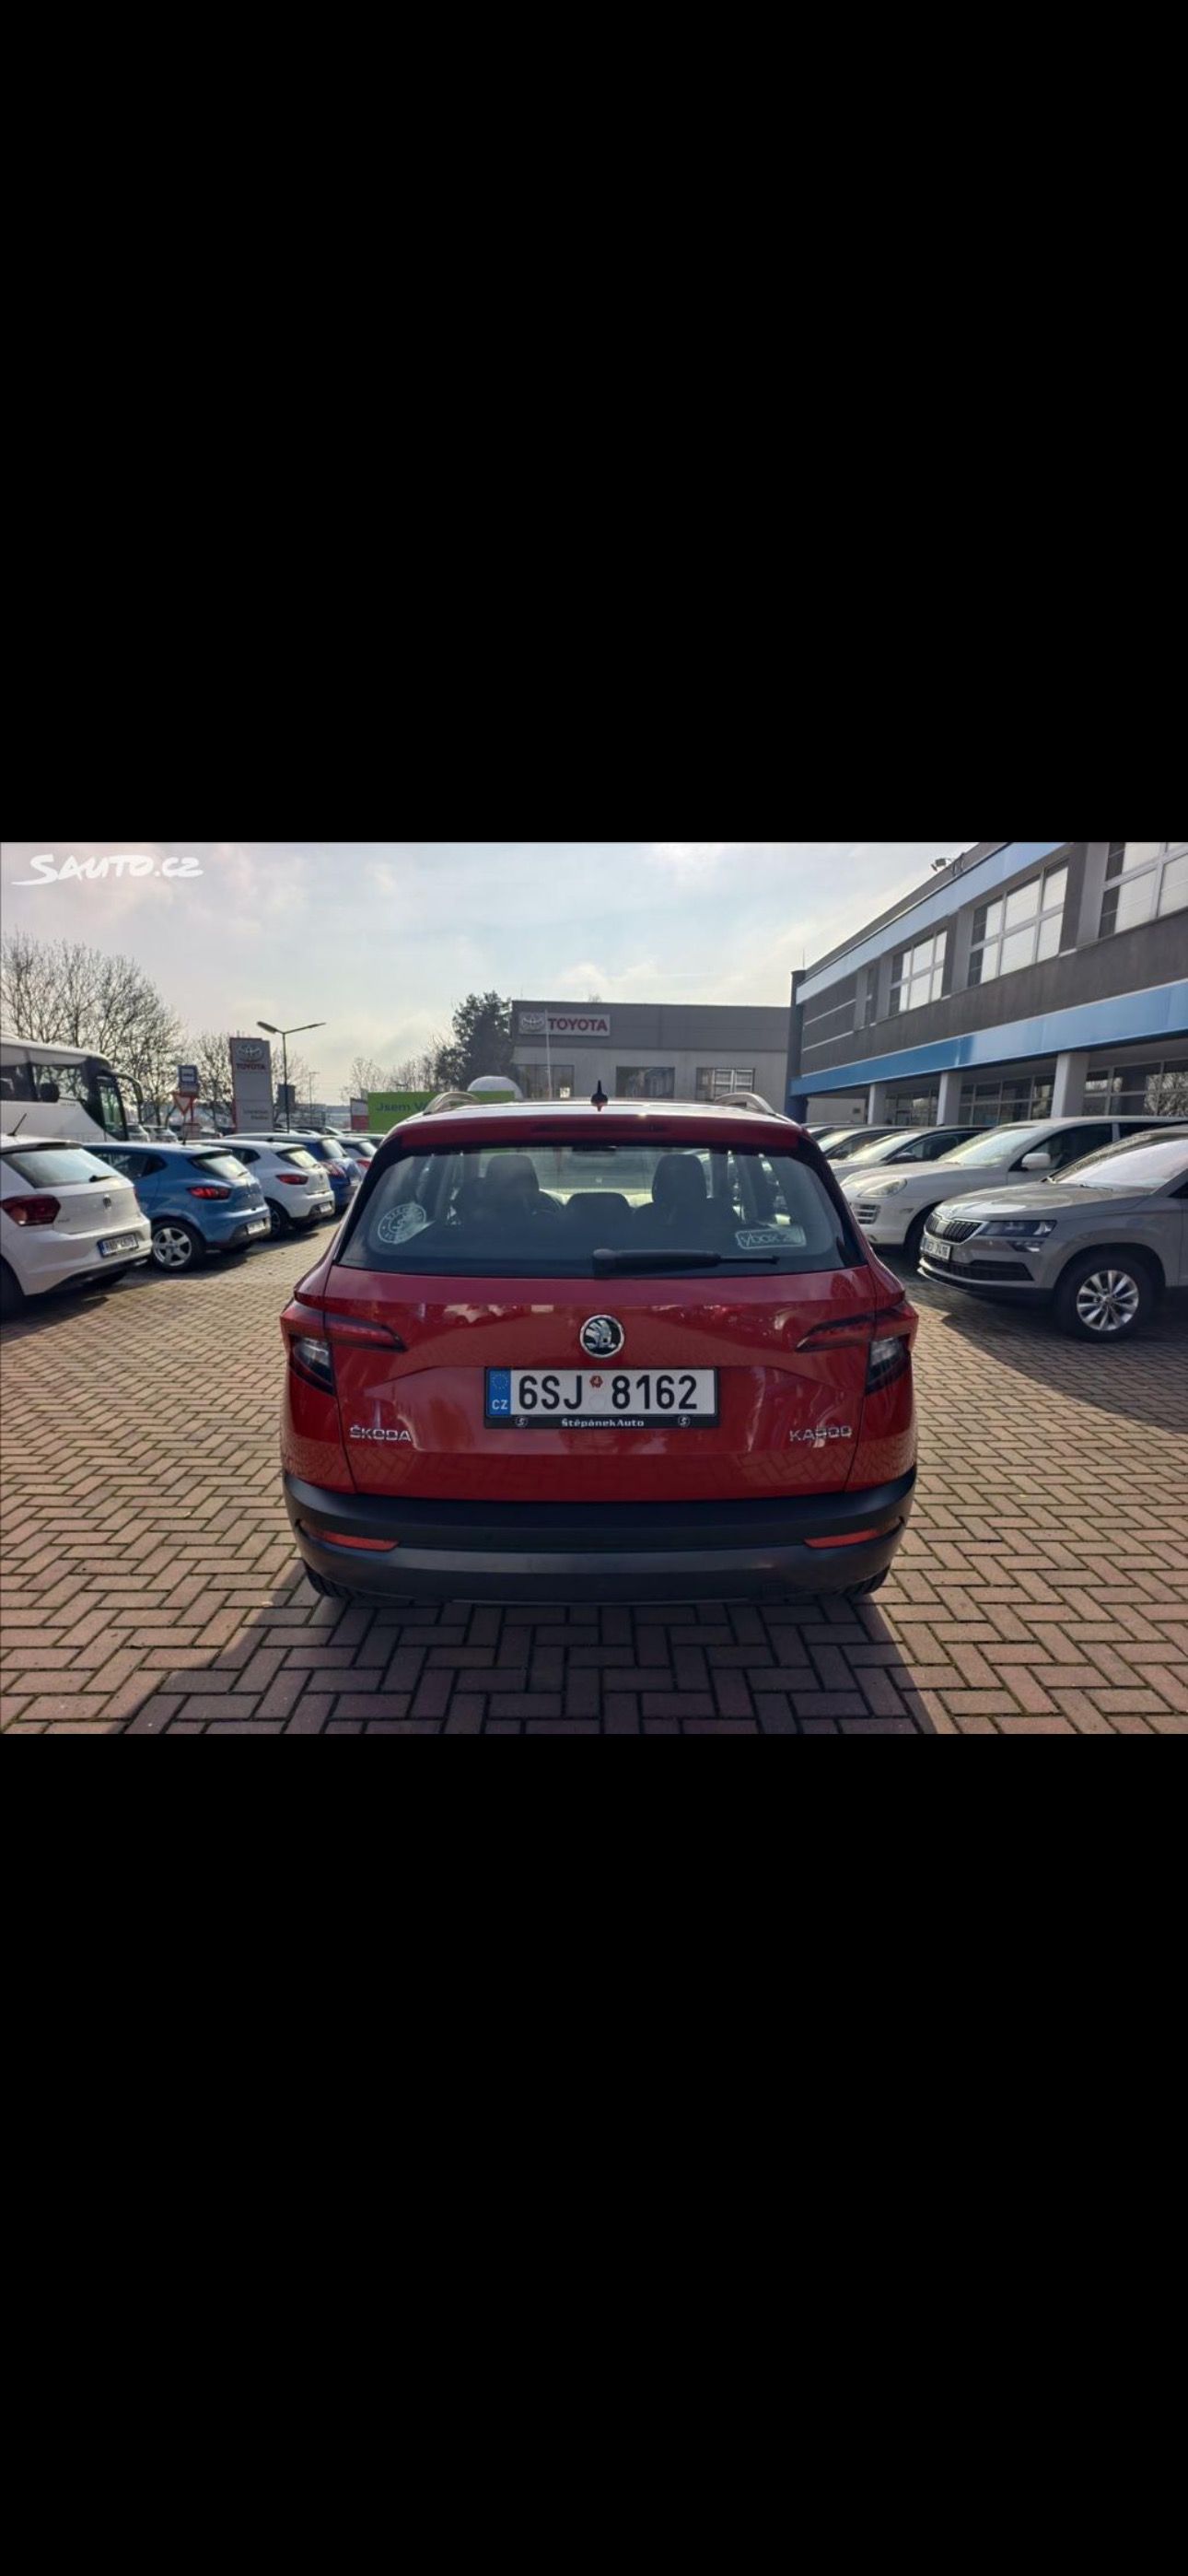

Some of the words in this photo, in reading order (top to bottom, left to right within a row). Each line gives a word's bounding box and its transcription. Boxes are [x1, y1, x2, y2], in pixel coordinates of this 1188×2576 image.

[547, 1017, 608, 1032] TOYOTA
[236, 1062, 266, 1071] TOYOTA
[518, 1375, 583, 1411] 6SJ
[611, 1375, 697, 1411] 8162
[491, 1399, 508, 1411] CZ
